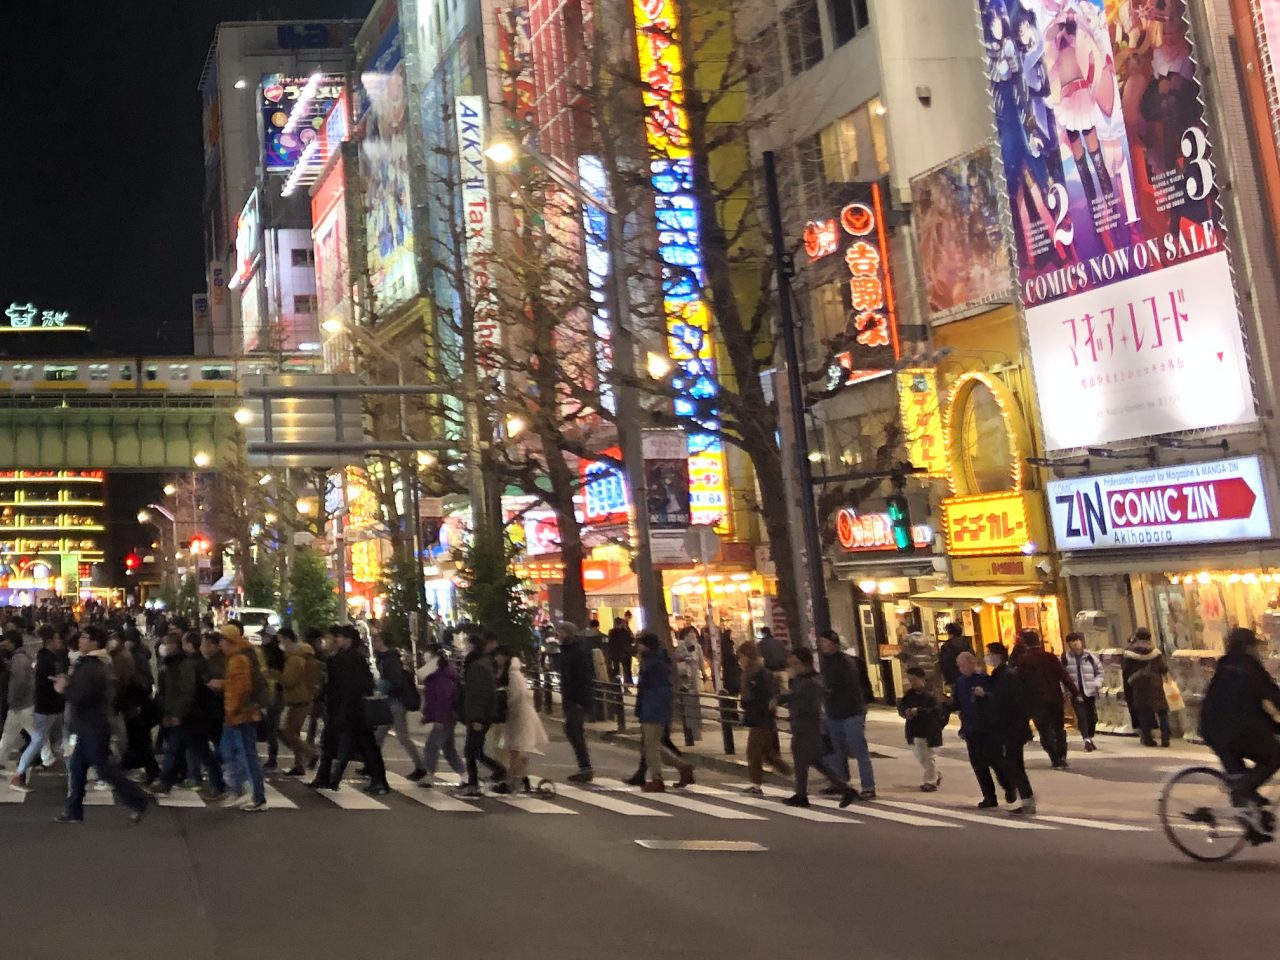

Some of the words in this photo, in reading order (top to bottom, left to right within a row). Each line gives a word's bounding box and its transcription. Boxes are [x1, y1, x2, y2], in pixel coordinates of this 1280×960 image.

[458, 101, 484, 170] AKKY
[1181, 126, 1213, 201] 3
[1048, 183, 1075, 248] 2
[1115, 159, 1141, 225] 1
[1025, 261, 1089, 304] COMICS
[1089, 246, 1130, 285] NOW
[1132, 237, 1161, 271] ON
[1163, 218, 1218, 261] SALE
[1055, 480, 1108, 544] ZIN
[1111, 491, 1182, 527] COMIC
[1183, 484, 1219, 520] ZIN
[1114, 529, 1173, 545] Akihabara
